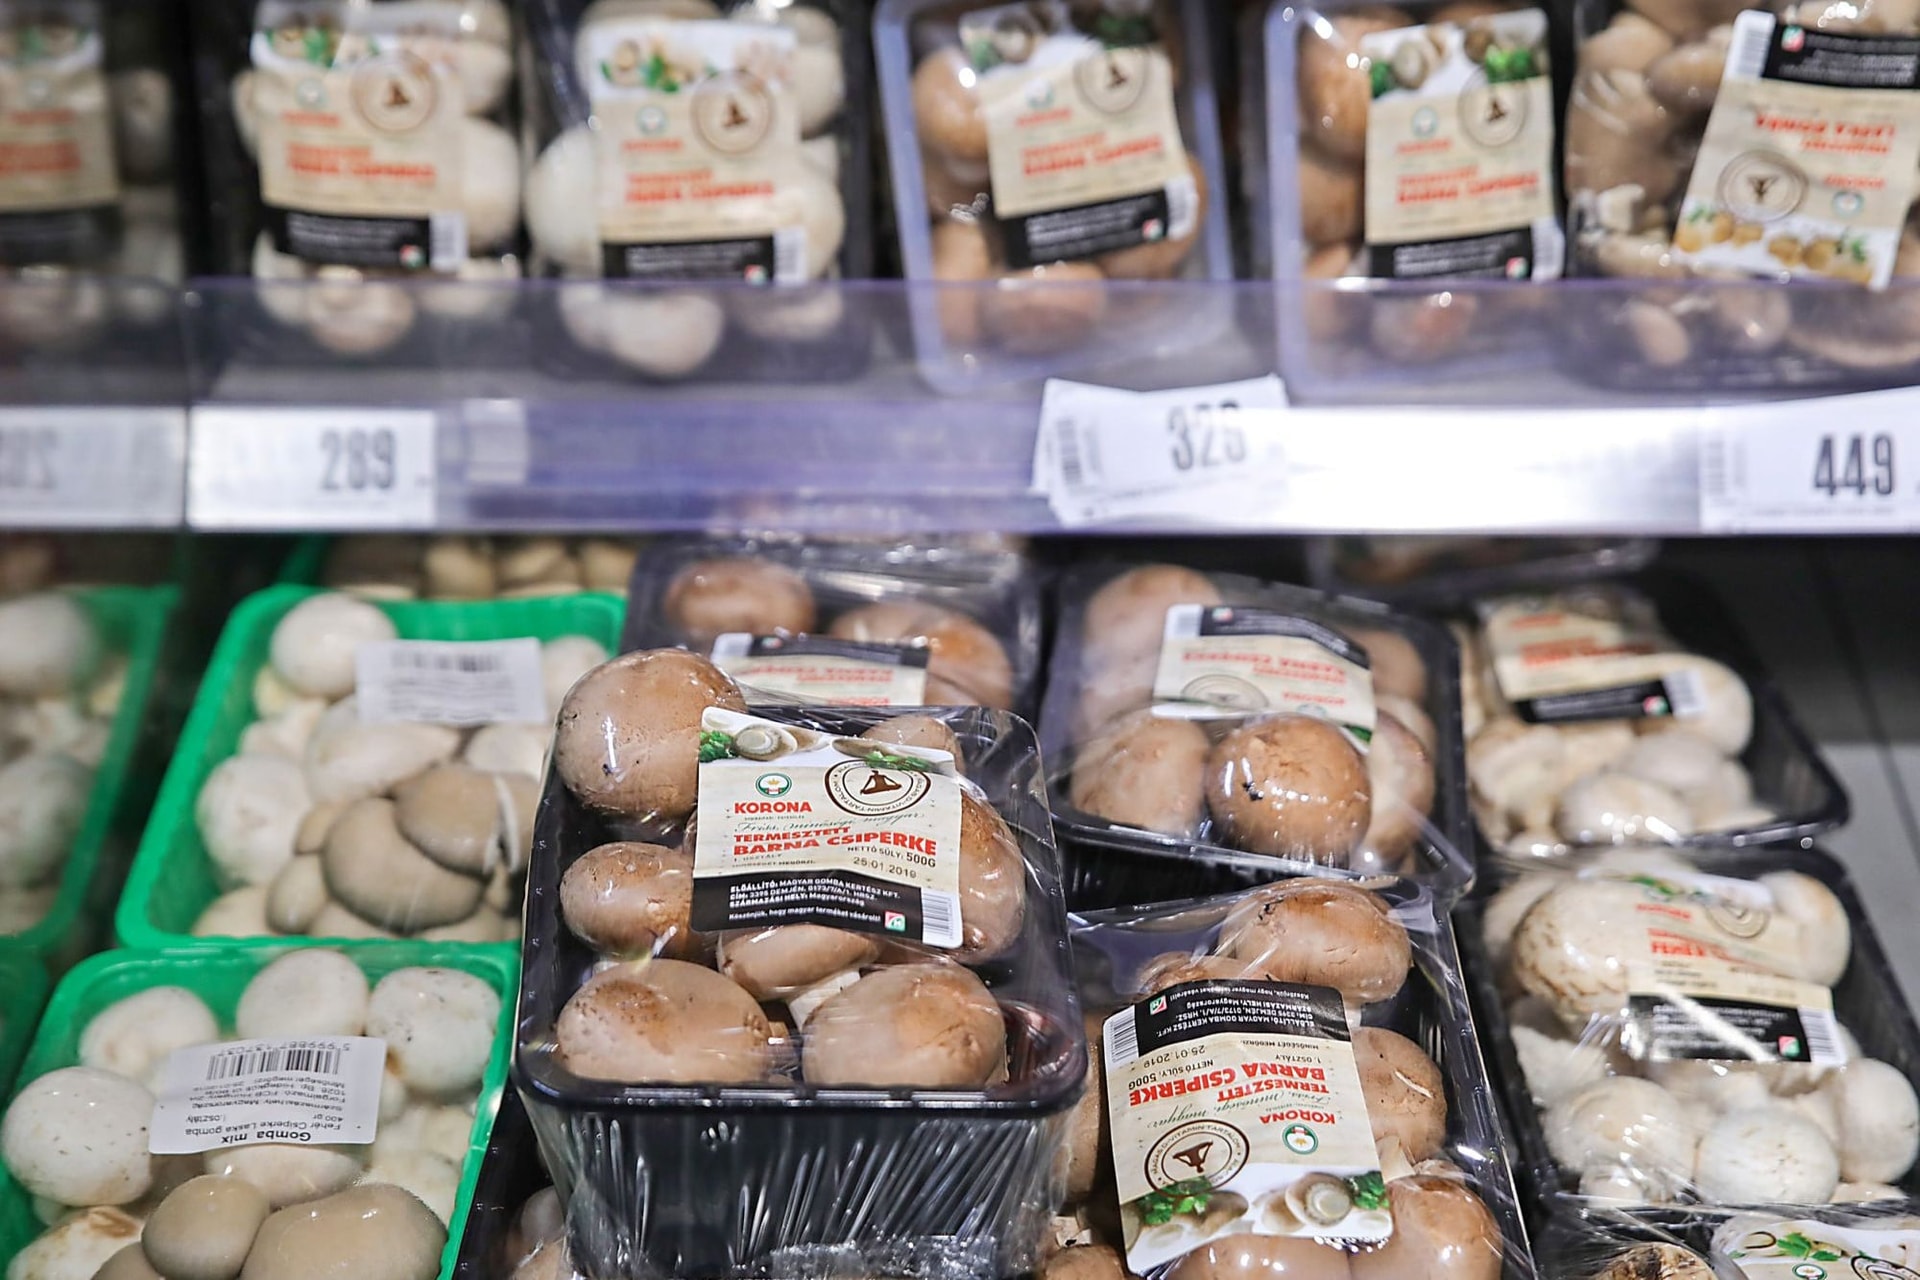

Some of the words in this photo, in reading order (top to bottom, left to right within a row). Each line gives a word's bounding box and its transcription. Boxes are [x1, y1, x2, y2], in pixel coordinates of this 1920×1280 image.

[320, 428, 396, 490] 289
[1814, 435, 1893, 496] 449
[734, 801, 812, 814] KORONA
[734, 826, 851, 842] TERMESZTETT
[734, 839, 820, 855] BARNA
[826, 831, 936, 856] CSIPERKE
[906, 852, 936, 868] 500G
[779, 878, 813, 886] MAGYAR
[814, 878, 844, 888] GOMBA
[845, 881, 881, 895] KERTÉSZ
[1173, 1018, 1208, 1031] KERTÉSZ
[1208, 1015, 1237, 1023] GOMBA
[1238, 1015, 1270, 1023] MAGYAR
[1156, 1026, 1172, 1037] KFT.
[1143, 1045, 1205, 1068] 25.01.2019
[1275, 1055, 1312, 1063] OSZTÁLY
[1186, 1060, 1213, 1073] NETTÓ
[1241, 1063, 1325, 1081] BARNA
[1128, 1073, 1156, 1090] 500G
[1129, 1068, 1236, 1107] CSIPERKE
[1217, 1079, 1329, 1102] TERMESZTETT
[324, 1115, 343, 1123] 400
[1259, 1110, 1335, 1124] KORONA
[185, 1125, 222, 1137] gomba
[225, 1122, 257, 1133] Laska
[259, 1121, 307, 1131] Csiperke
[309, 1121, 341, 1131] Fehér
[220, 1133, 247, 1144] mix
[256, 1131, 311, 1142] Gomba
